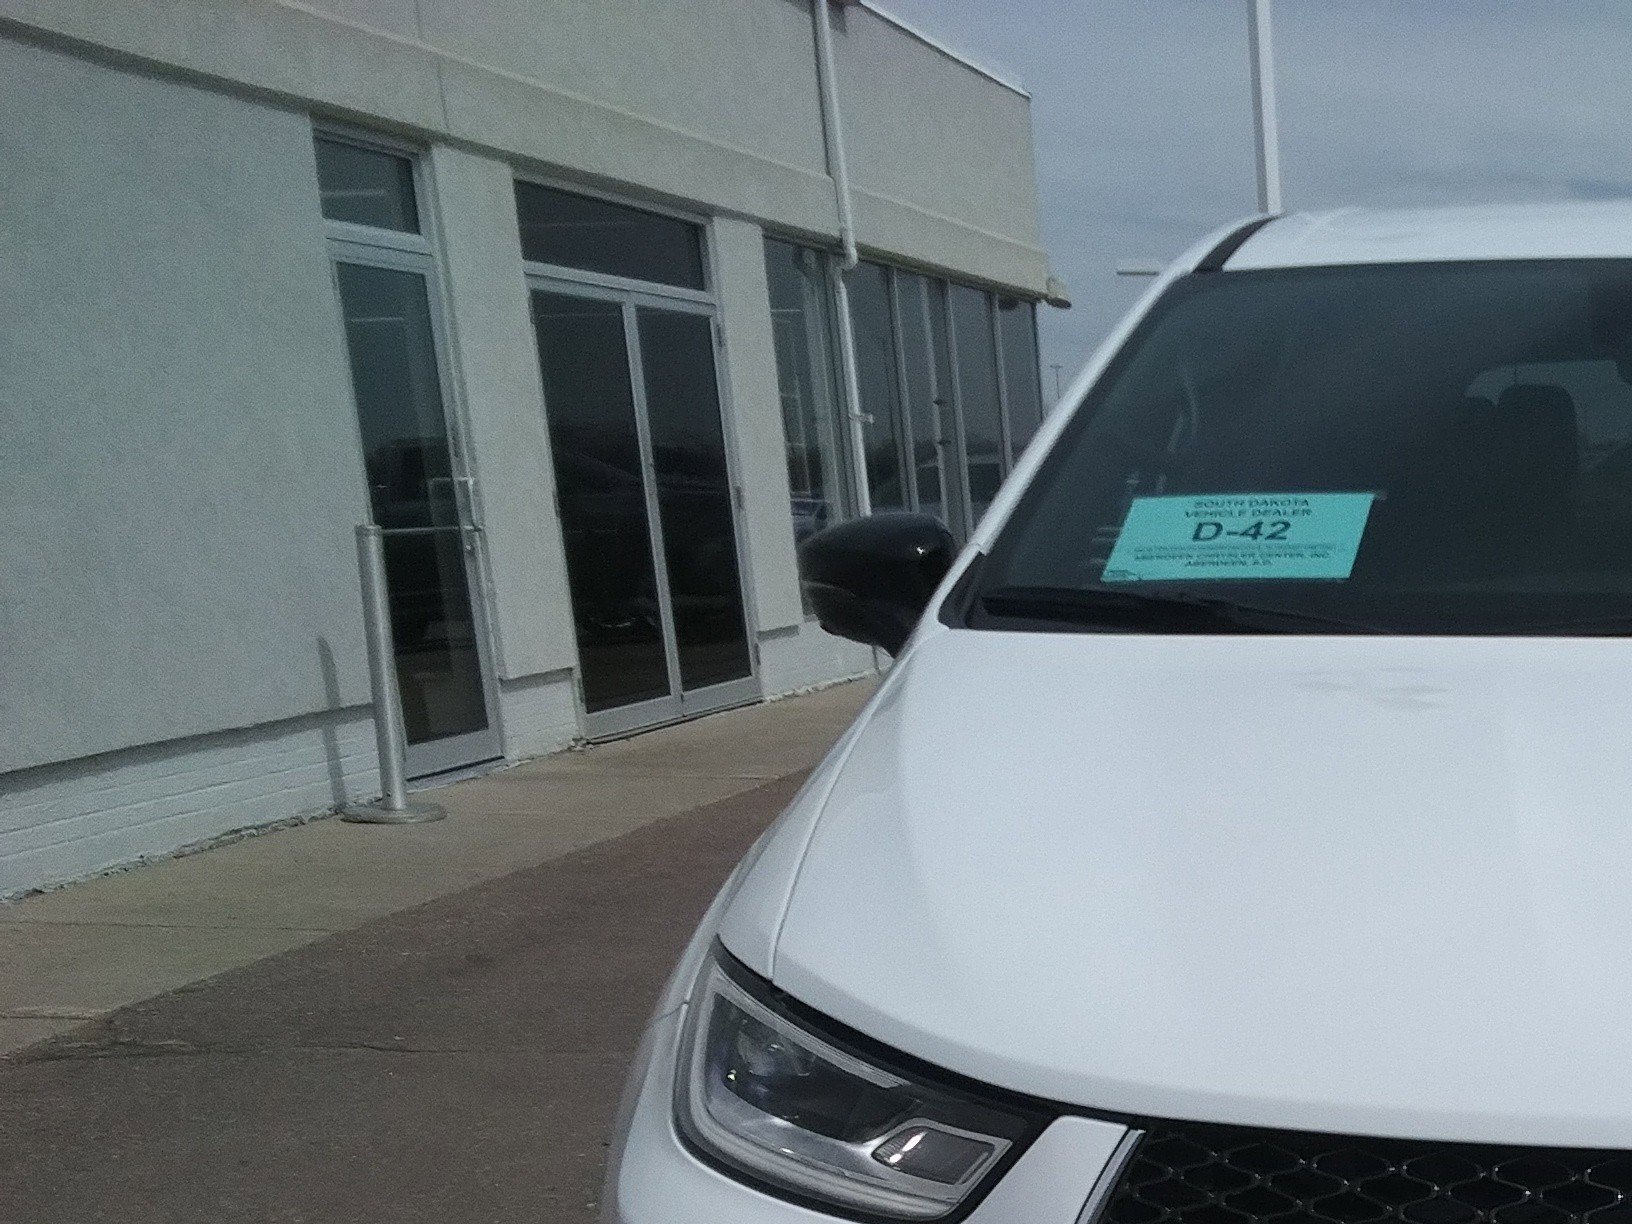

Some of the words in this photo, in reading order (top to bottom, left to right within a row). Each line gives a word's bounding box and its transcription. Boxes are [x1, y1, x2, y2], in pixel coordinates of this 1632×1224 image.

[1193, 499, 1246, 508] SOUTH
[1248, 498, 1310, 508] DAKOTA
[1184, 509, 1248, 518] VEHICLE
[1250, 508, 1313, 517] DEALER
[1191, 519, 1292, 542] D-42
